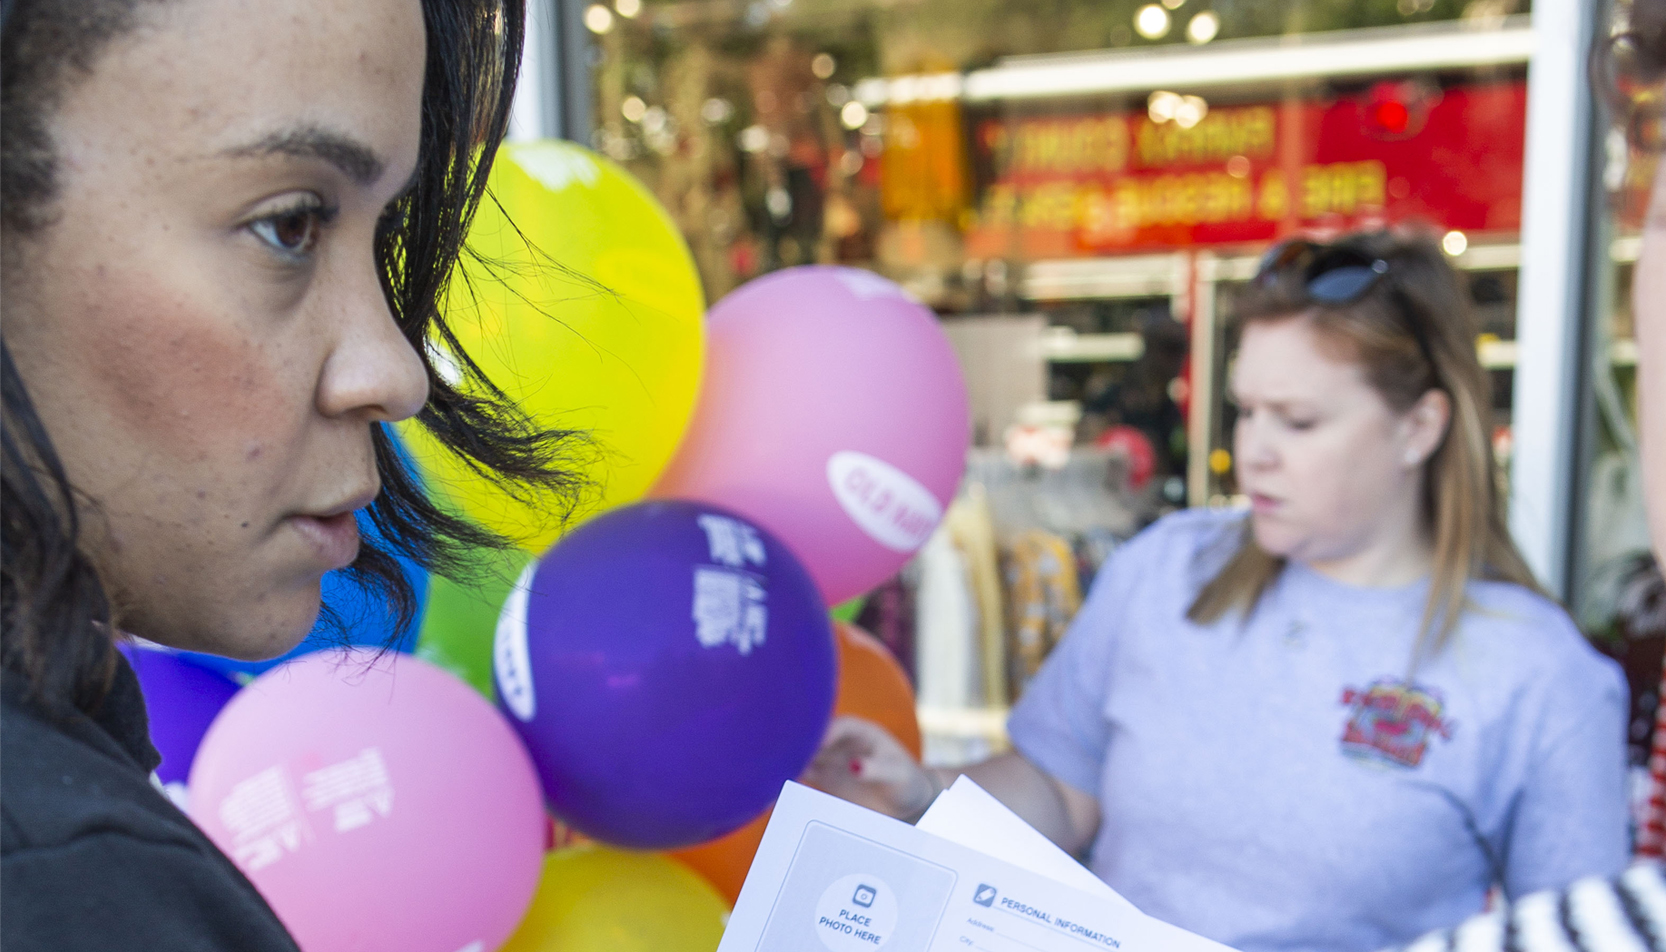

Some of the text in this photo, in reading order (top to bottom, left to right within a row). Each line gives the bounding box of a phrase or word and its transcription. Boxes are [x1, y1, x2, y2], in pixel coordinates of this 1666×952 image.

[819, 916, 882, 945] PHOTO HERE
[838, 909, 872, 927] PLACE
[1001, 897, 1121, 949] PERSONAL INFORMATION
